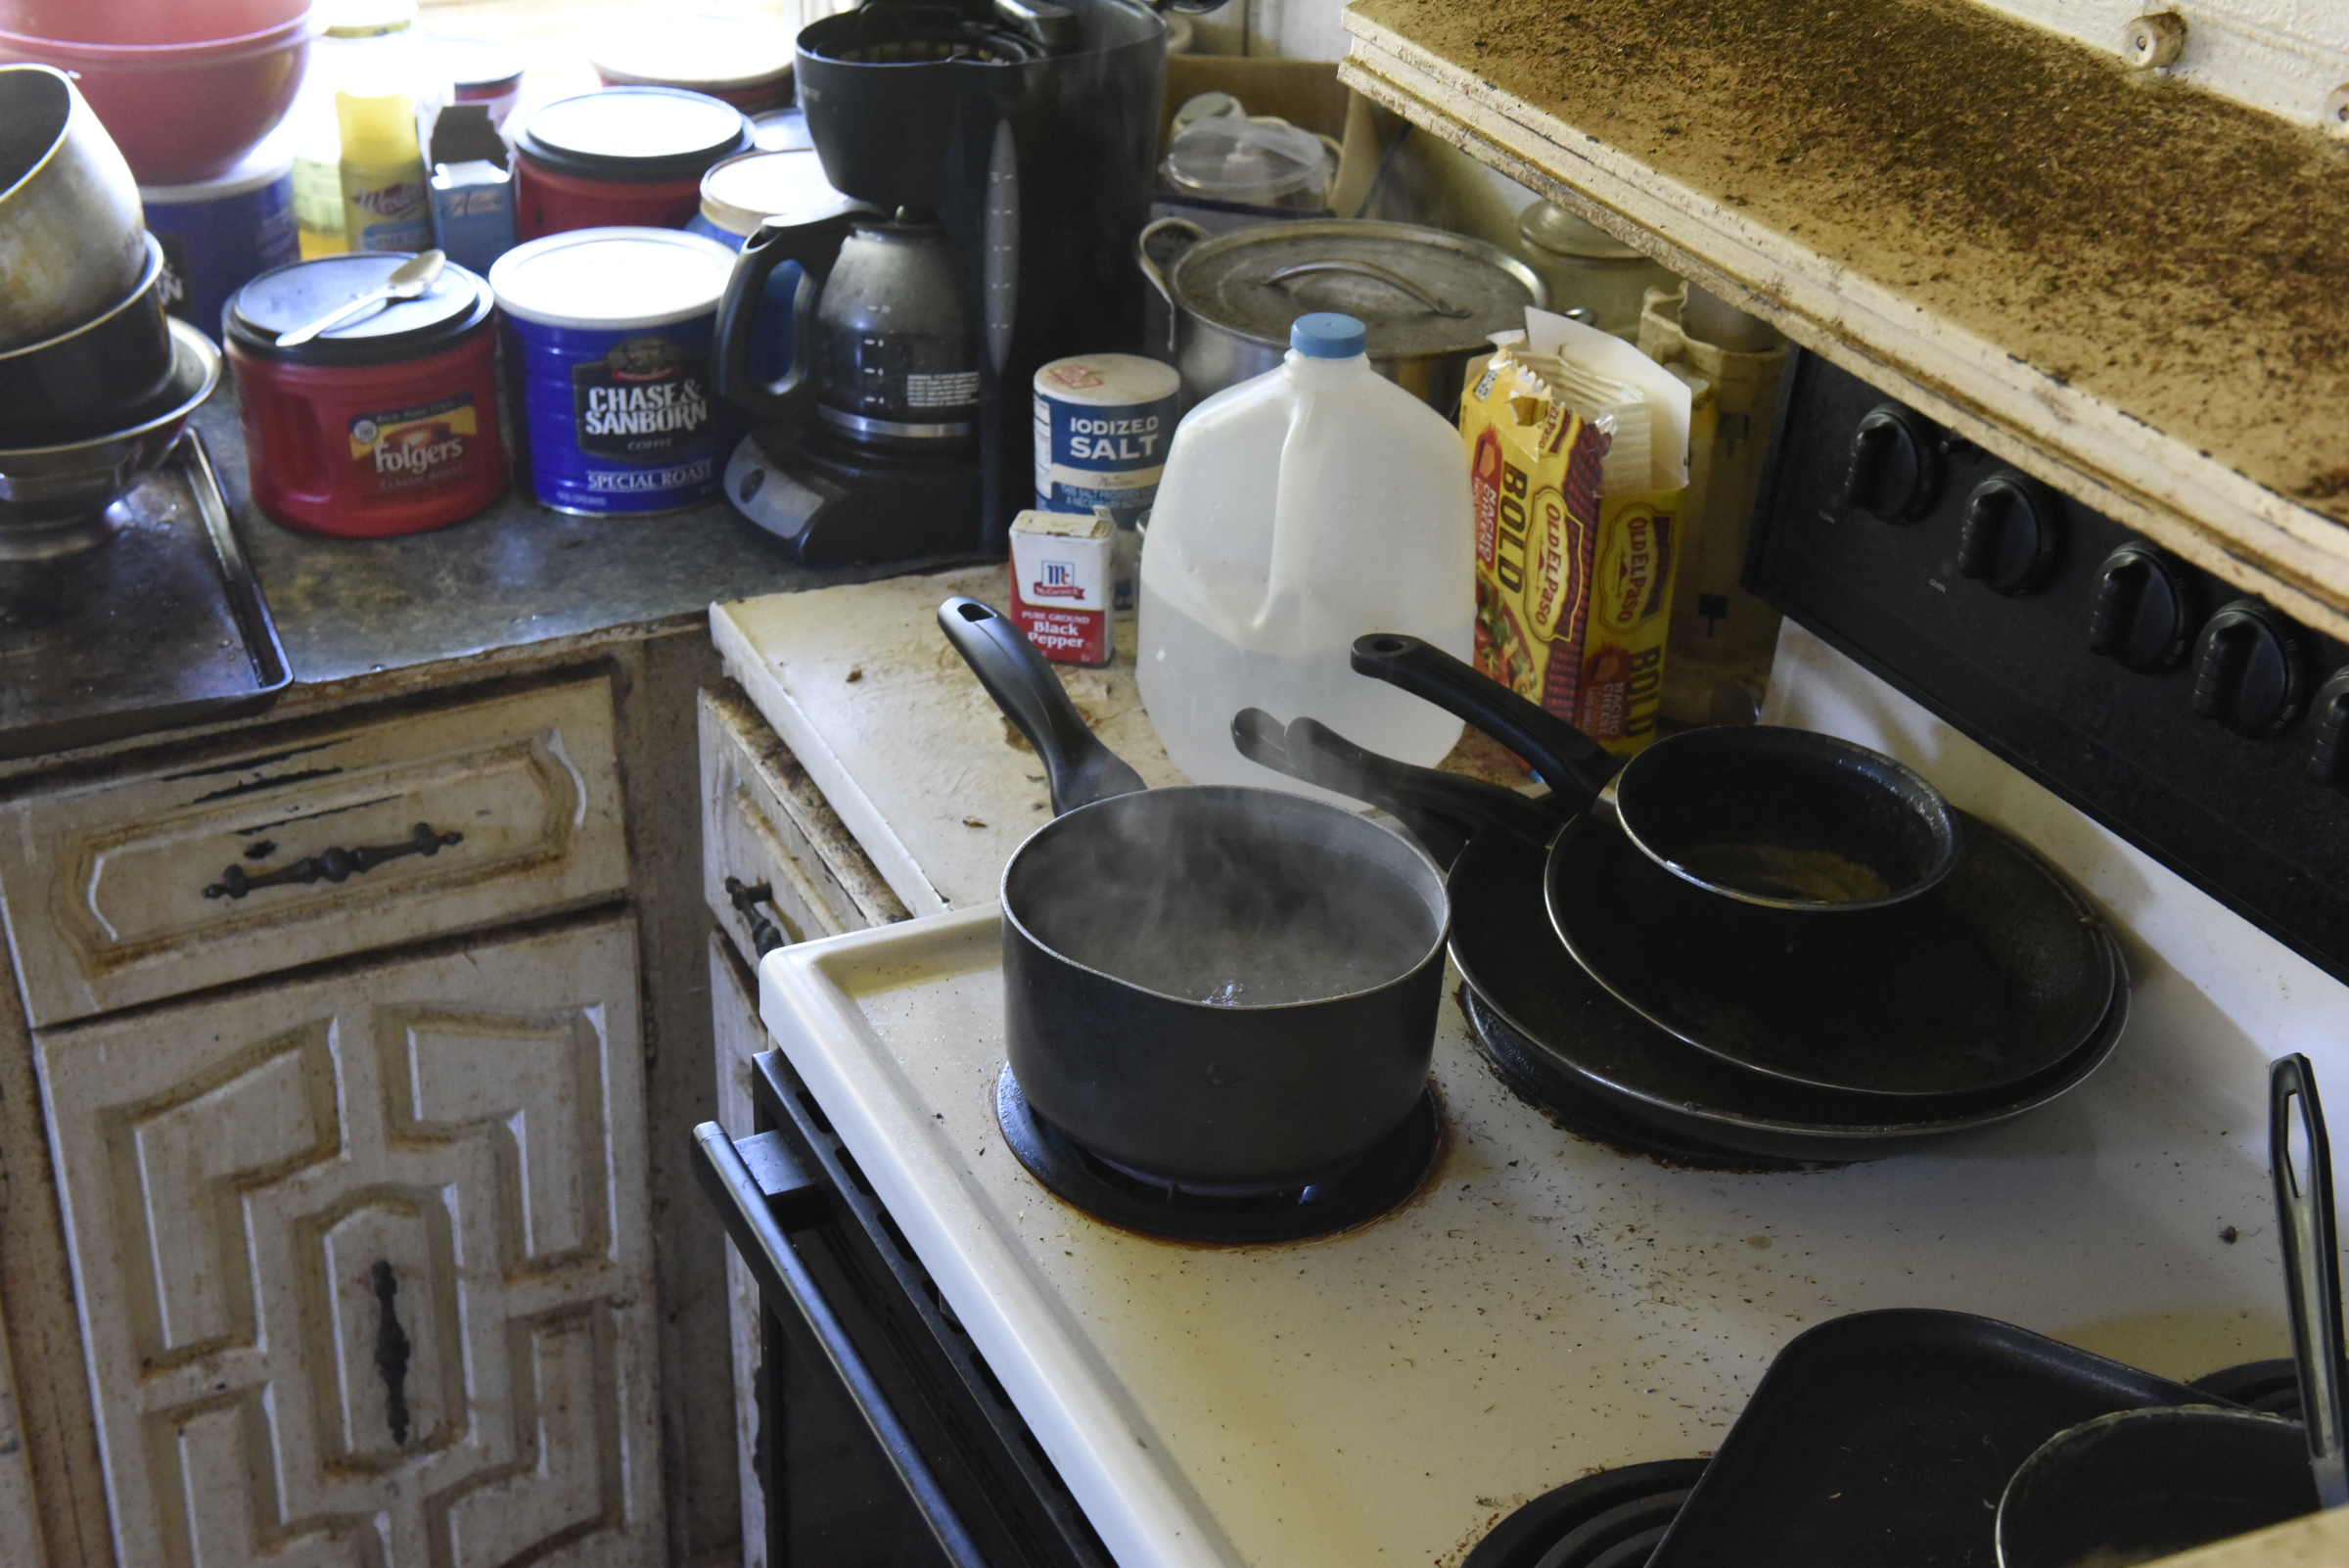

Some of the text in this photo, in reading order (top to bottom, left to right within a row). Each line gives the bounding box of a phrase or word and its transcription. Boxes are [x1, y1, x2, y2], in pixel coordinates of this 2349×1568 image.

[588, 379, 702, 412] CHASE &
[585, 400, 707, 435] SANBORN
[1070, 416, 1159, 435] IODIZED
[375, 438, 463, 474] Folgers
[1070, 434, 1159, 460] SALT
[588, 461, 713, 489] SPECIAL ROAST
[1484, 489, 1497, 563] NACHO
[1498, 460, 1528, 594] BOLD
[1545, 503, 1561, 547] OLD
[1627, 517, 1648, 552] OLD
[1544, 551, 1561, 579] EL
[1630, 552, 1650, 576] EL
[1021, 611, 1090, 624] PURE GROUND
[1033, 620, 1079, 636] Black
[1028, 631, 1084, 651] Pepper
[1625, 645, 1662, 738] BOLD
[1597, 683, 1614, 737] CHEESE
[1608, 682, 1625, 736] NACHO
